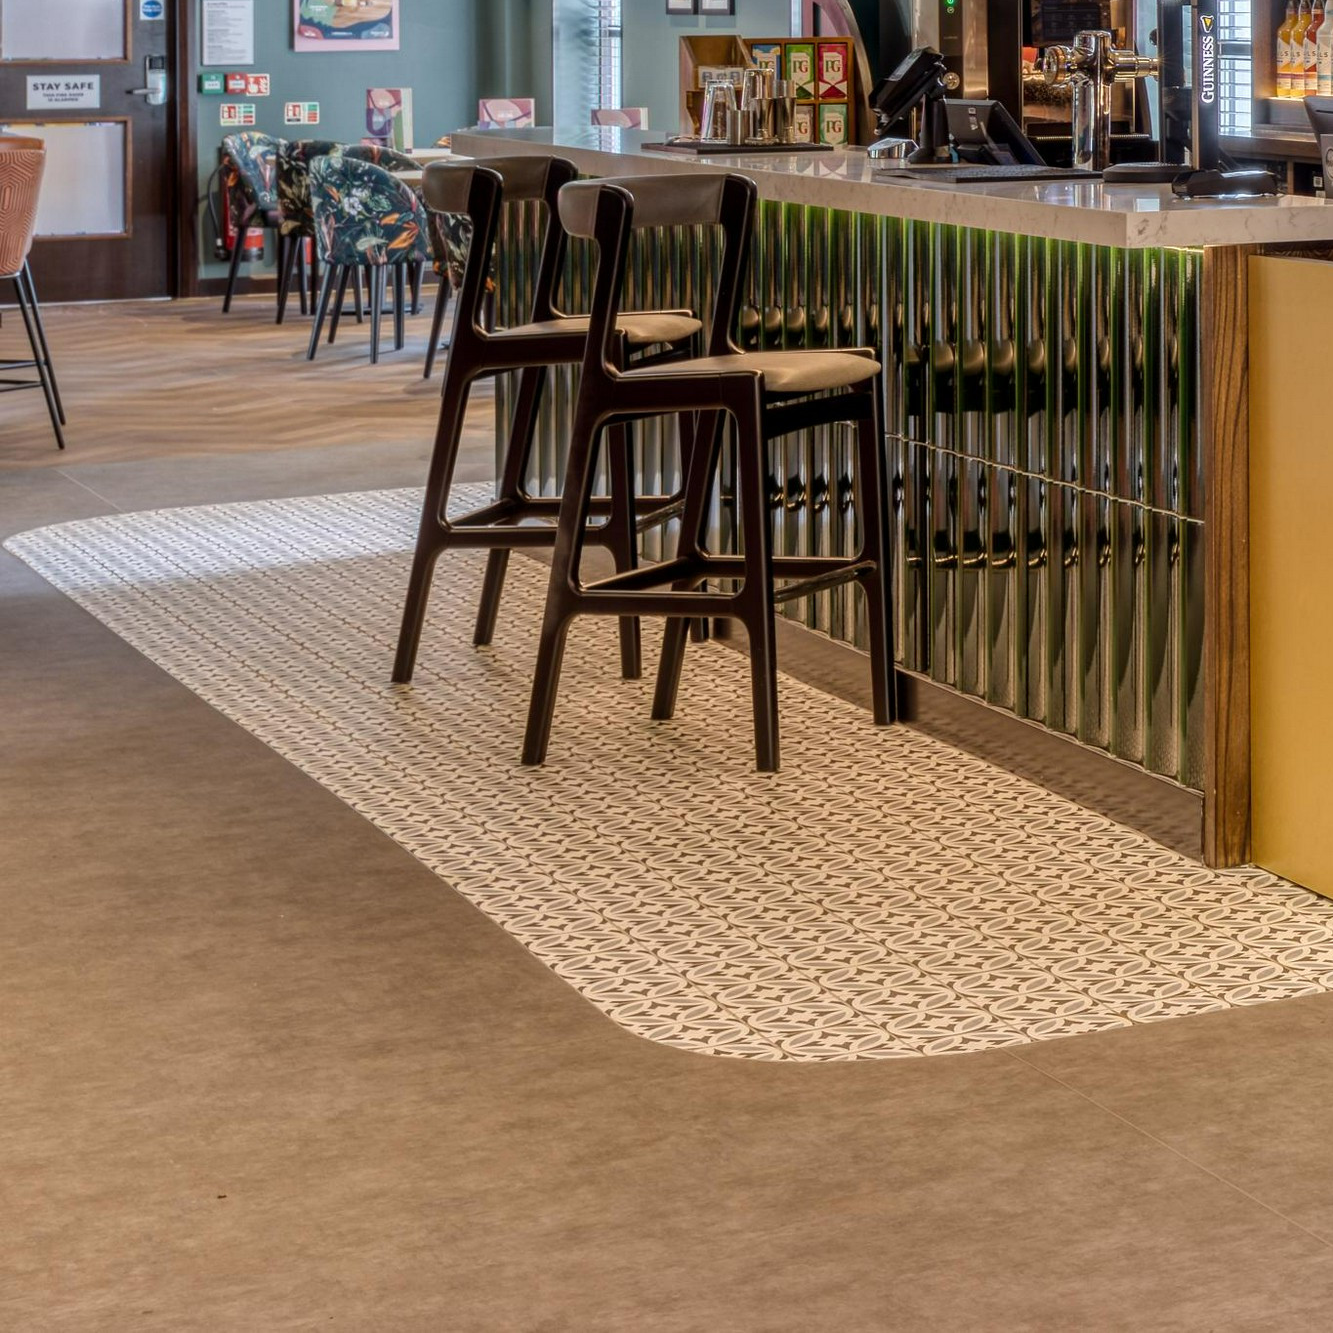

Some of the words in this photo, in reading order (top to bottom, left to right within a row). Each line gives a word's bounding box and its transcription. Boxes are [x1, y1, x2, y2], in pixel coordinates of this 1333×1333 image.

[793, 59, 808, 74] PG
[825, 59, 841, 73] PG
[1202, 36, 1215, 104] GUINNESS
[33, 82, 60, 91] STAY
[65, 82, 94, 90] SAFE
[826, 120, 842, 133] PG
